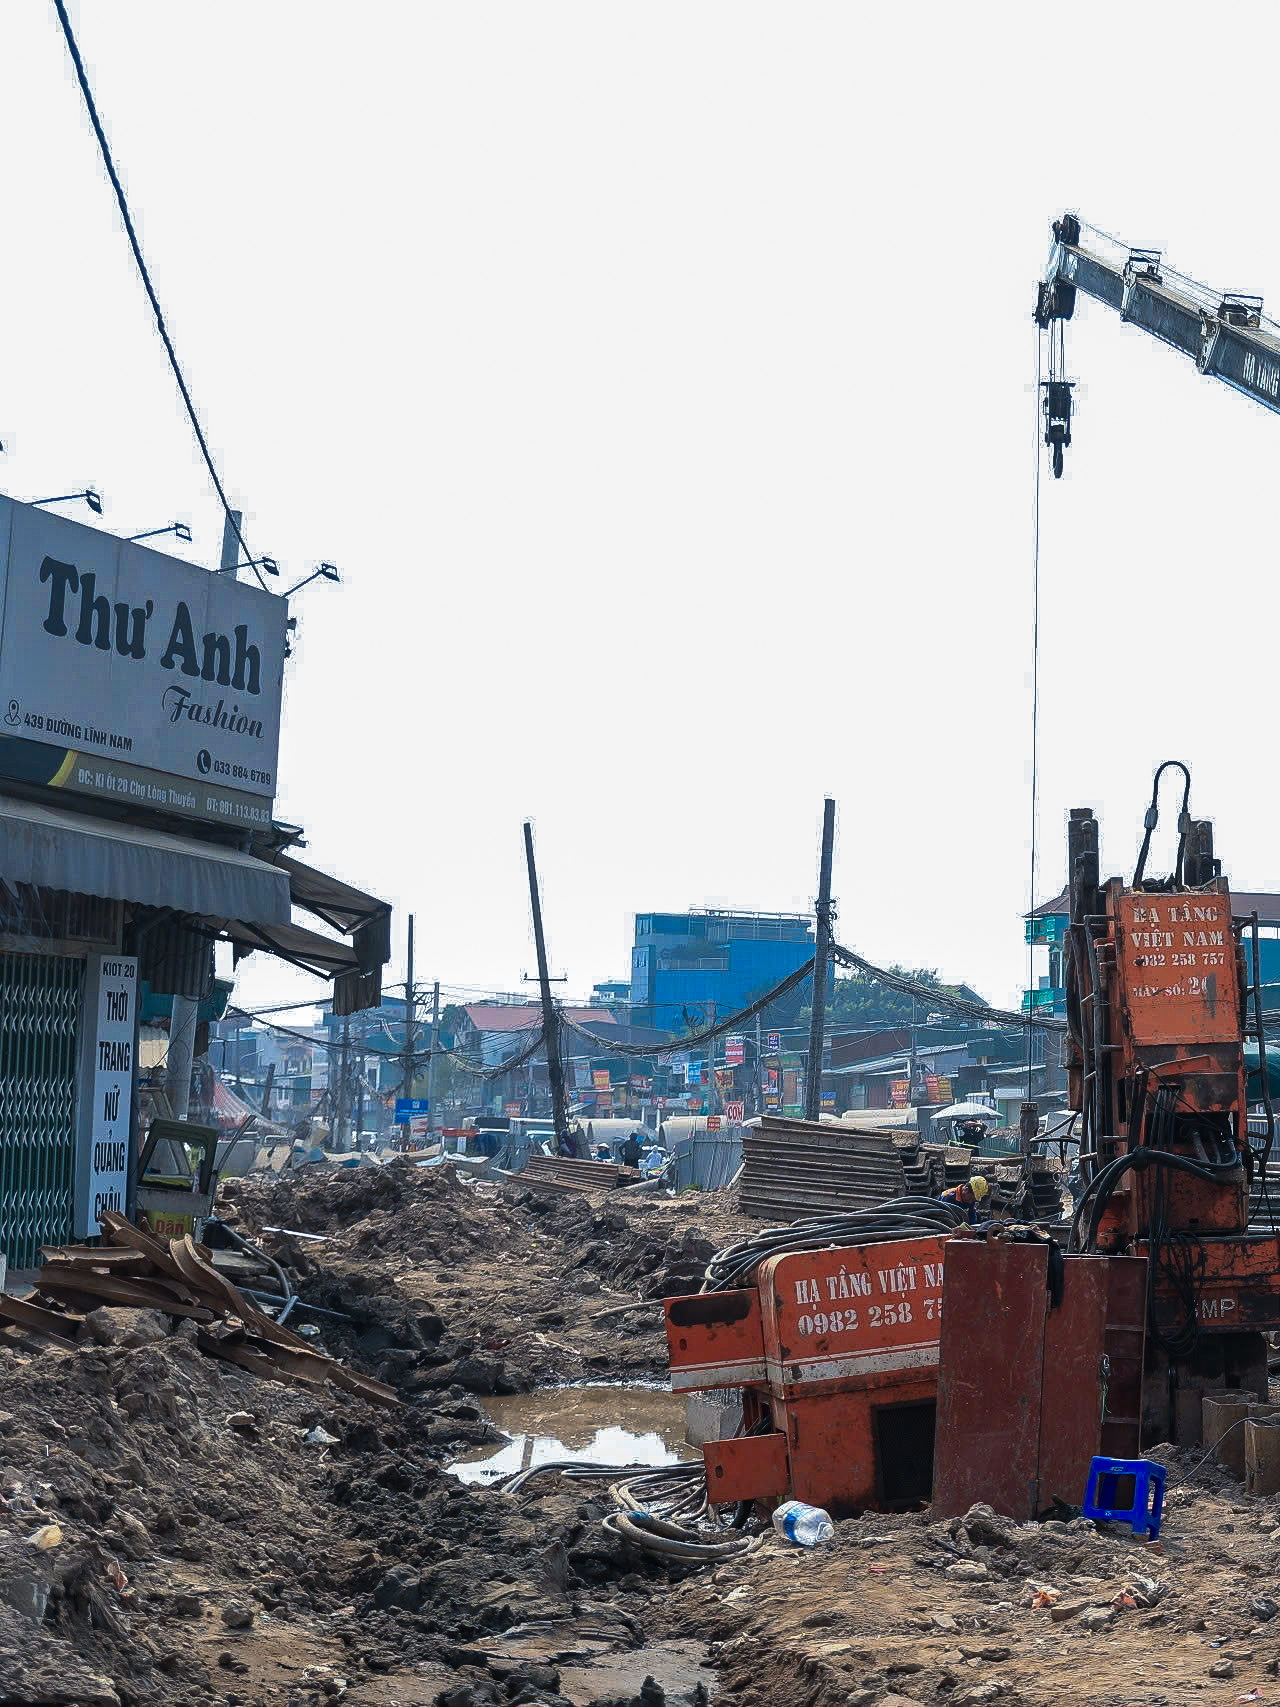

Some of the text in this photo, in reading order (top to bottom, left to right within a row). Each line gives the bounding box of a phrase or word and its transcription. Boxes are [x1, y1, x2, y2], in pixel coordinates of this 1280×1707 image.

[39, 556, 261, 695] Thư Anh
[162, 685, 265, 738] Fashion
[24, 713, 133, 752] 439 ĐƯỜNG LĨNH NAM
[214, 760, 271, 785] 033 884 6789
[1167, 900, 1218, 922] TẦNG
[1130, 928, 1224, 952] VIỆT NAM
[103, 961, 135, 978] KIOT 20
[1171, 953, 1197, 967] 258
[1202, 952, 1225, 966] 757
[107, 984, 128, 1022] THỜI
[99, 1041, 131, 1072] TRANG
[104, 1084, 120, 1122] NỮ
[94, 1129, 126, 1175] QUẢNG
[794, 1261, 944, 1311] HẠ TẦNG VIỆT NA
[798, 1309, 859, 1336] 0982
[868, 1302, 913, 1328] 258
